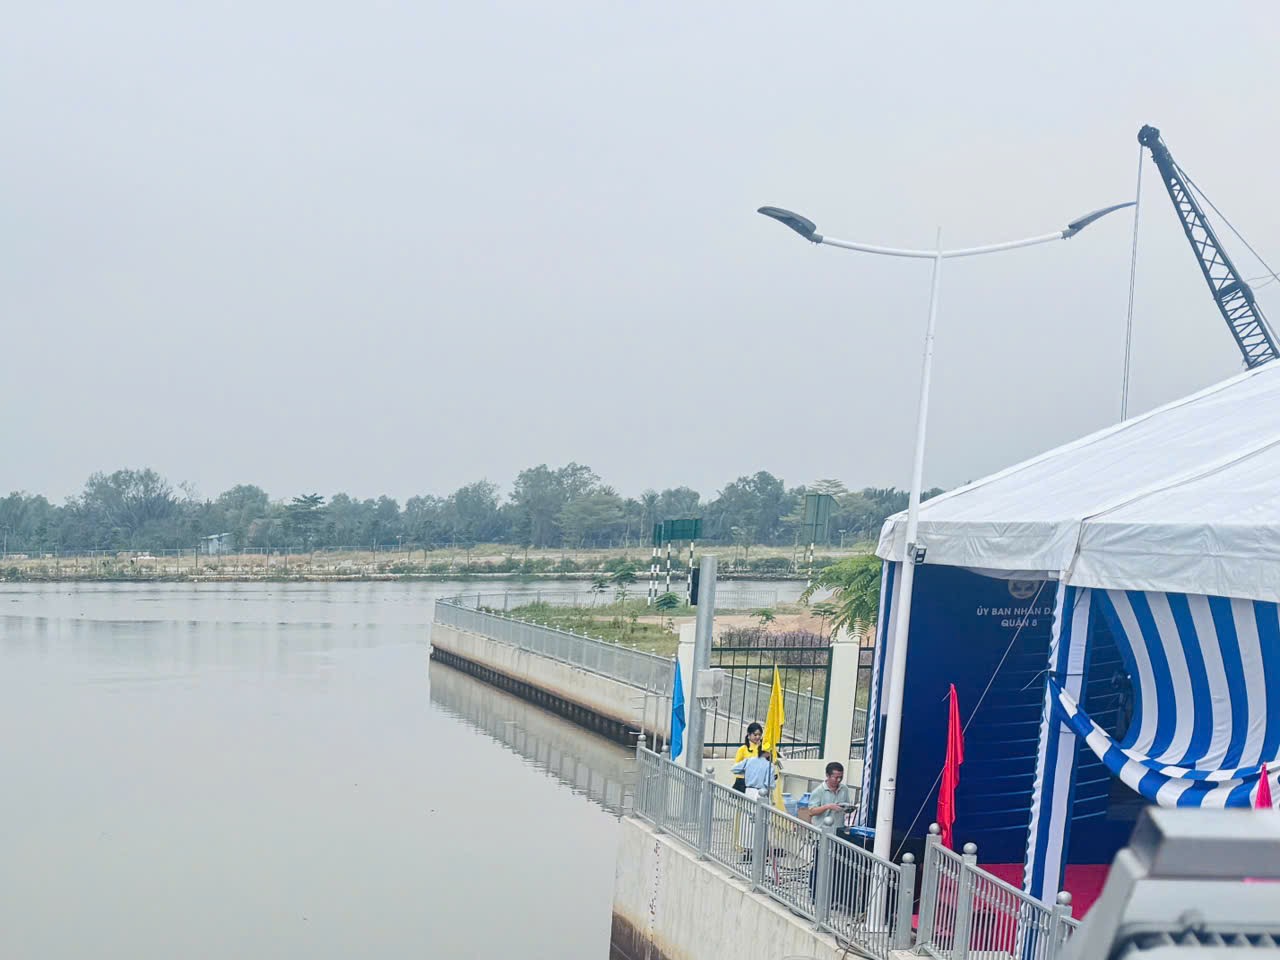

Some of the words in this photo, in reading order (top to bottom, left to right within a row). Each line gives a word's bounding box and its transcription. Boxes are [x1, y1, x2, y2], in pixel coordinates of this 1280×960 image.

[976, 605, 989, 616] ỦY
[991, 607, 1011, 616] BAN
[1031, 618, 1038, 627] 8
